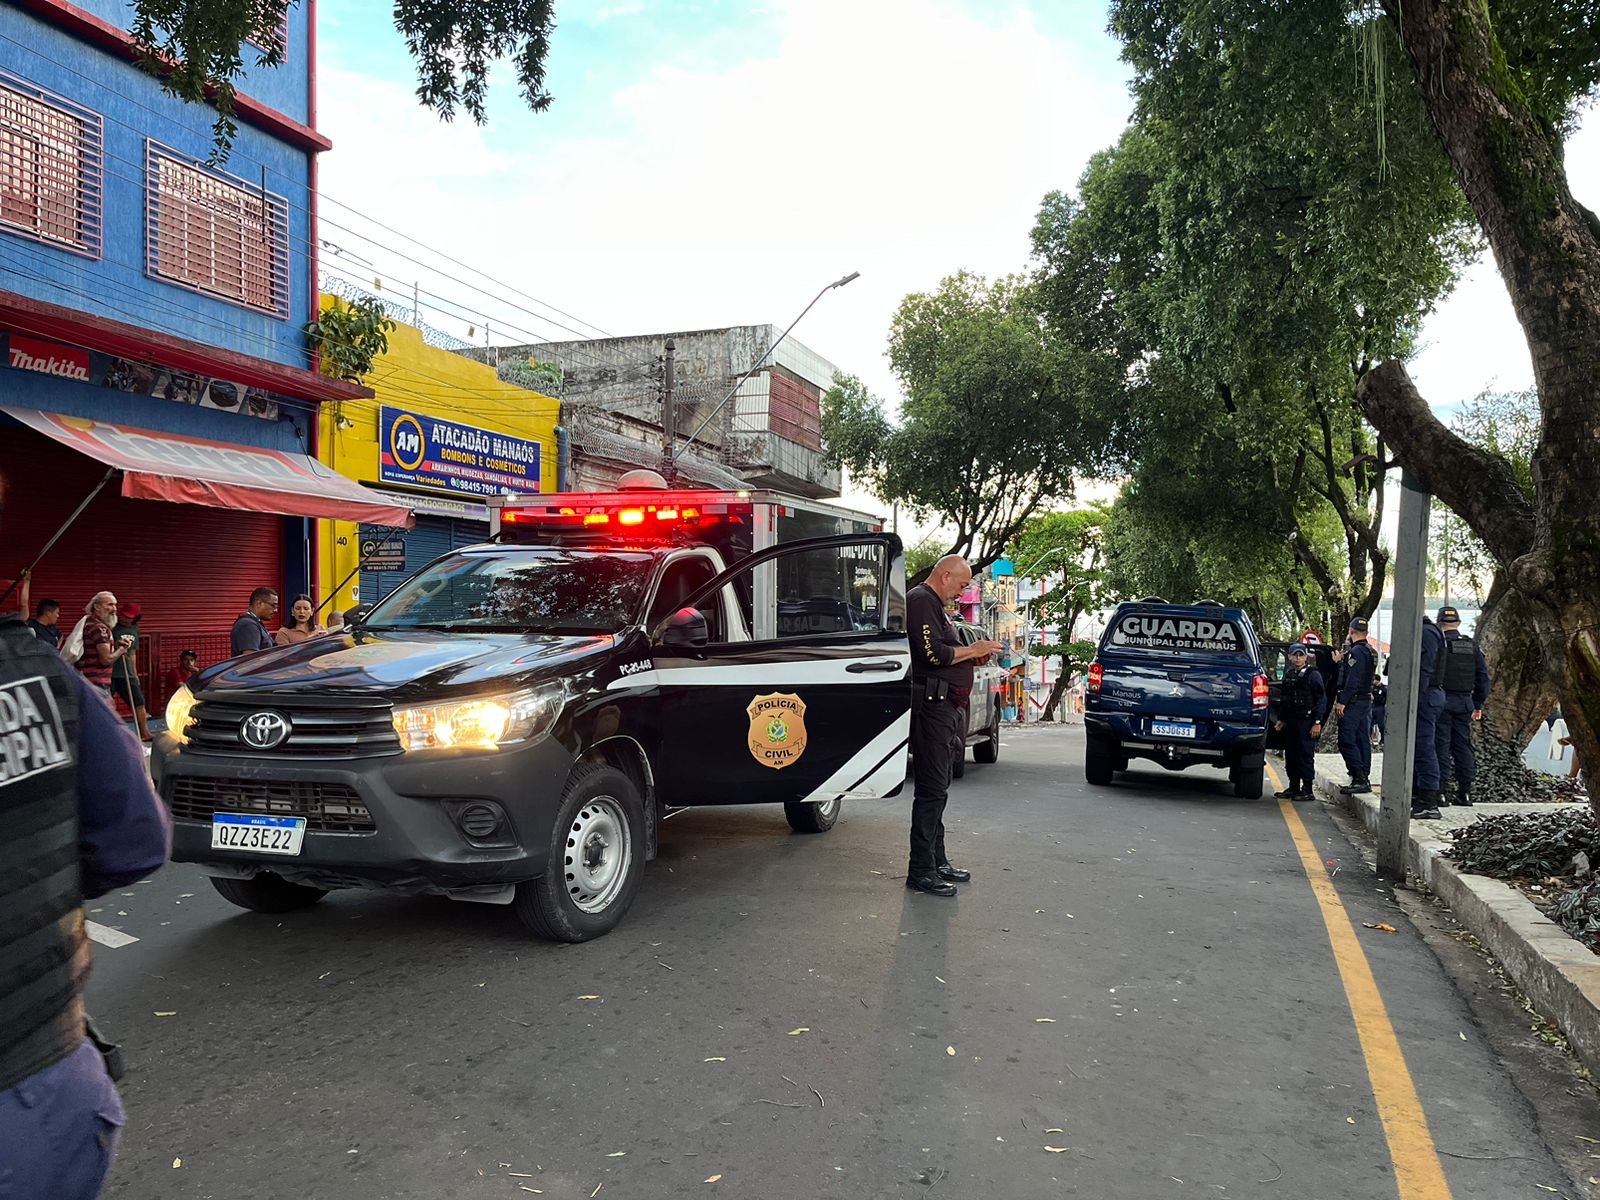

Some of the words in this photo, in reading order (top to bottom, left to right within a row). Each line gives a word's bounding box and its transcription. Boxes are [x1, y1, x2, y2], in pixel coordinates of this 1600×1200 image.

[396, 431, 420, 453] AM
[431, 423, 490, 454] ATACADÃO
[492, 440, 534, 464] MANAÓS
[441, 447, 476, 466] BOMBONS
[478, 455, 483, 467] E
[485, 457, 526, 475] COSMÉTICOS
[459, 480, 497, 495] 98415-7991
[336, 536, 348, 546] 40
[1122, 617, 1236, 641] GUARDA
[1125, 636, 1175, 647] MUNICIPAL
[1176, 640, 1191, 648] DE
[1192, 641, 1237, 652] MANAUS
[1112, 689, 1142, 699] Manaus
[765, 749, 793, 758] CIVIL
[219, 825, 293, 850] QZZ3E22
